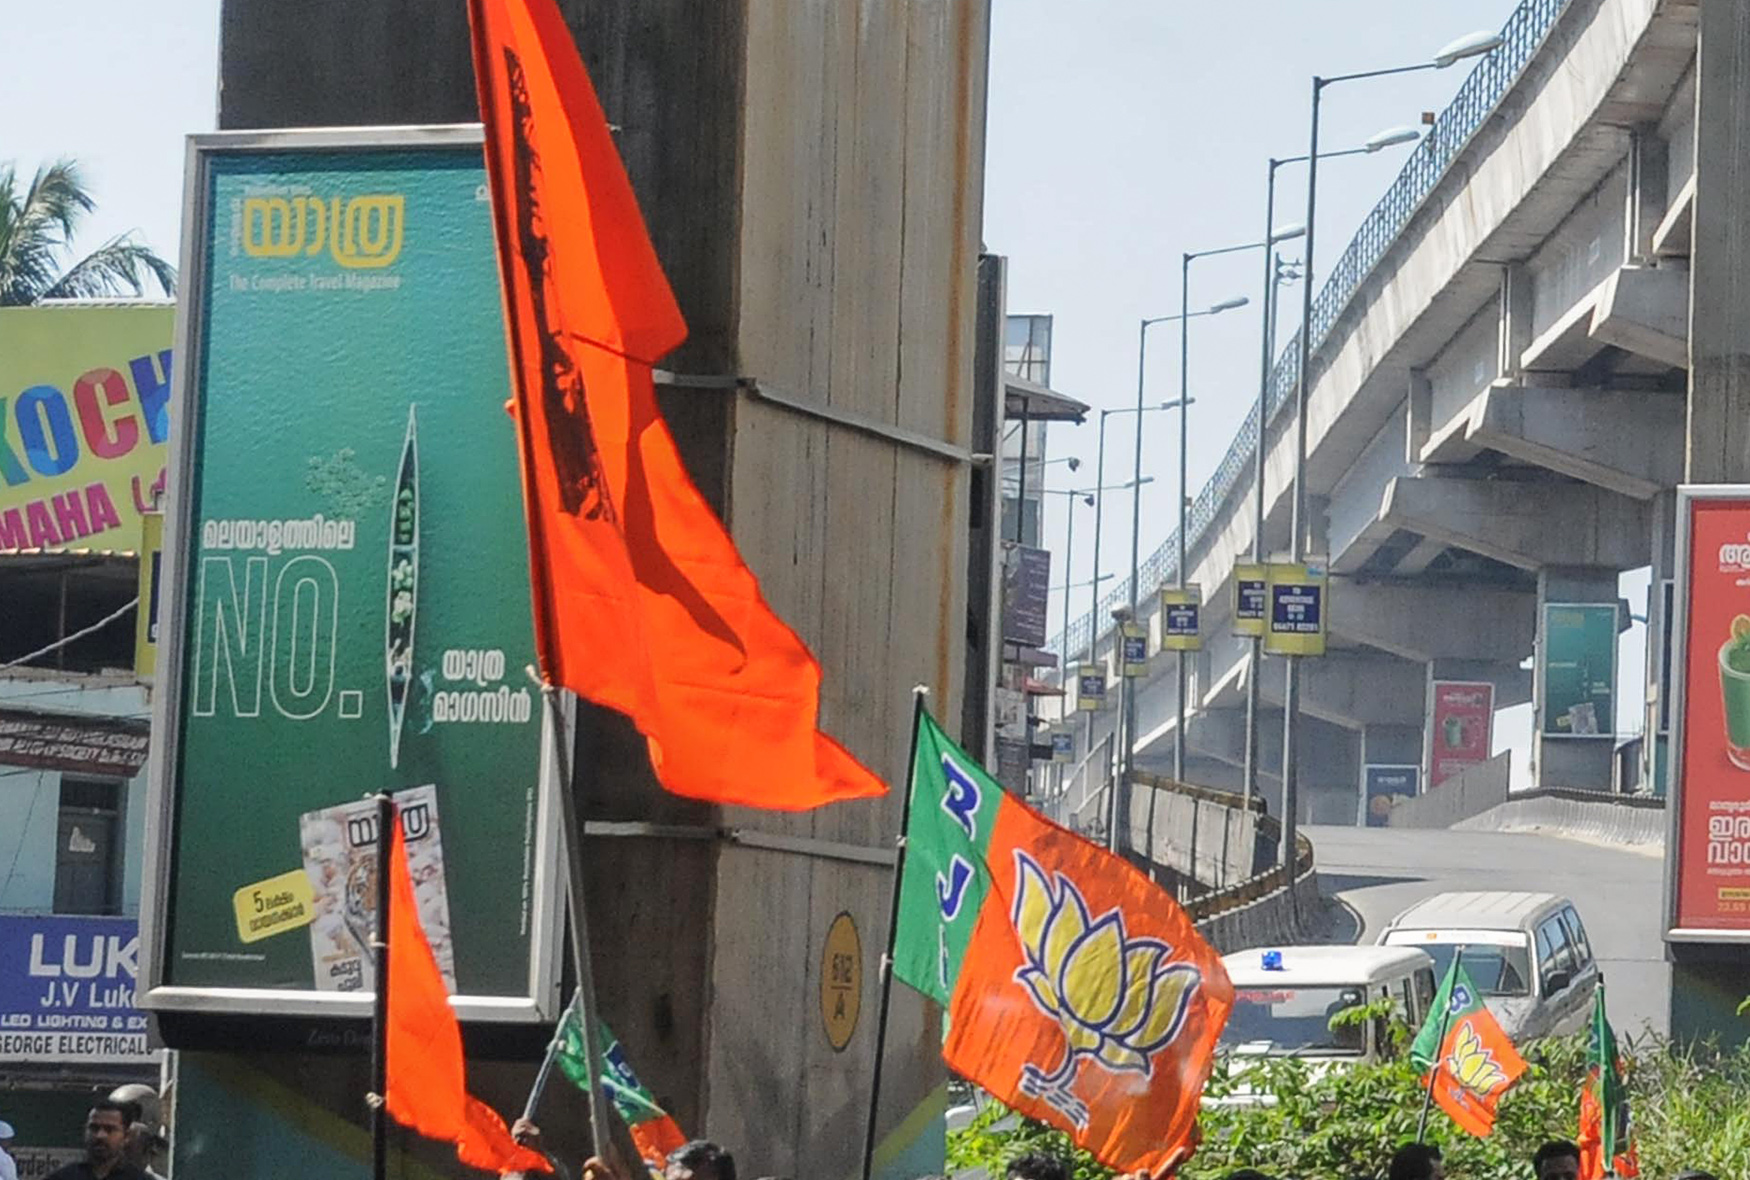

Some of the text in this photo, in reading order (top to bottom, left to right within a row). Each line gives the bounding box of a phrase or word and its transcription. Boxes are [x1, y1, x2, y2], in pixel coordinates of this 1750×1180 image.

[253, 274, 305, 292] Complete
[309, 274, 344, 290] Travel
[347, 274, 402, 293] Magazine
[203, 514, 357, 555] മലയാളത്തിലെ
[193, 555, 364, 720] NO.
[443, 649, 505, 687] യാത്ര
[433, 685, 532, 723] മാഗസിൻ
[252, 891, 264, 914] 5
[40, 981, 80, 1008] J.V
[1, 1014, 32, 1026] LED
[37, 1014, 108, 1029] LIGHTING
[111, 1016, 123, 1029] &
